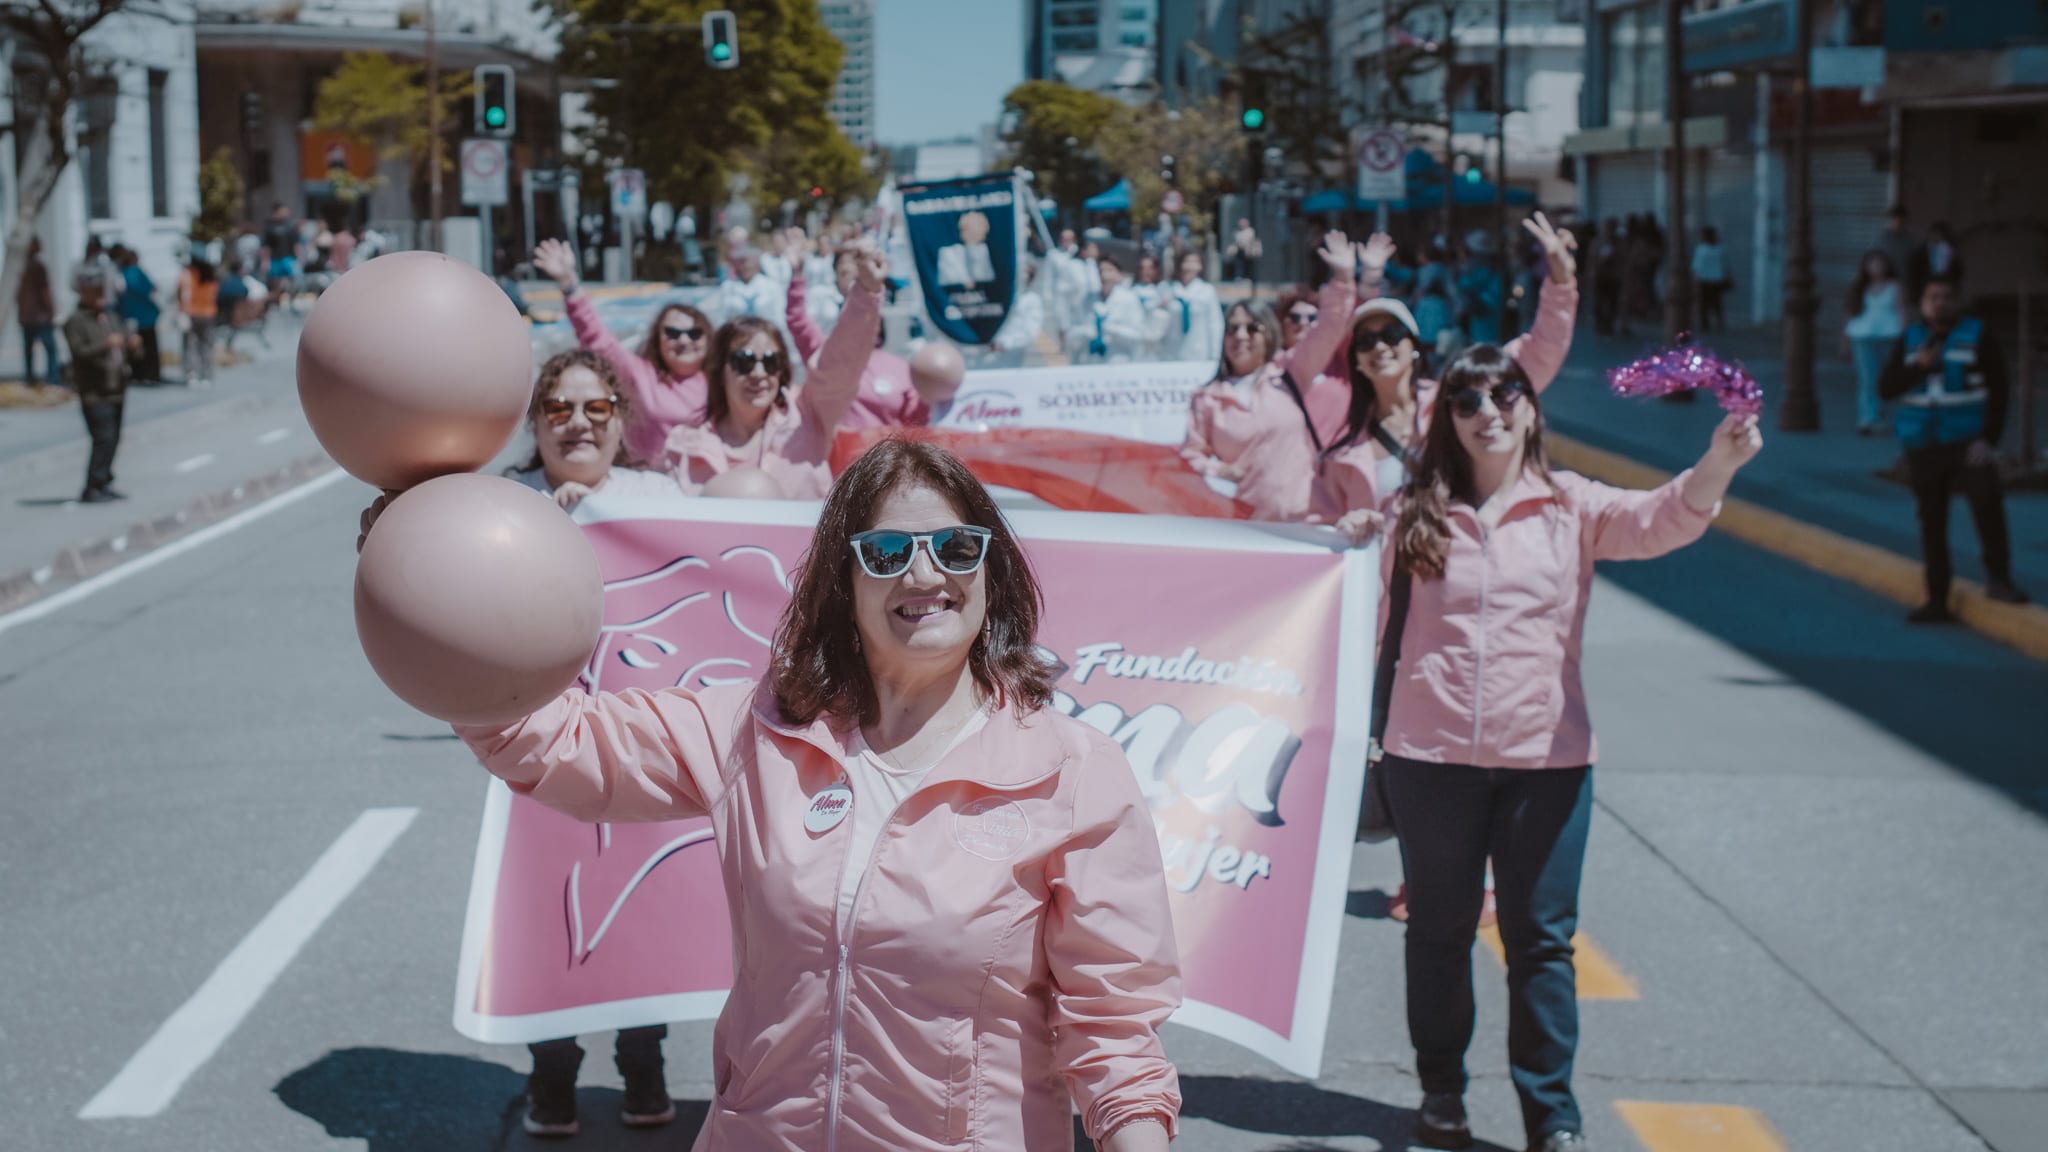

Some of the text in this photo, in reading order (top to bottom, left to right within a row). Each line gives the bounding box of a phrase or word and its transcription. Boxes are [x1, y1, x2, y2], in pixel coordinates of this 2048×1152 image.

[1072, 642, 1304, 696] Fundación
[810, 793, 846, 812] Alma
[1152, 816, 1270, 893] ujer
